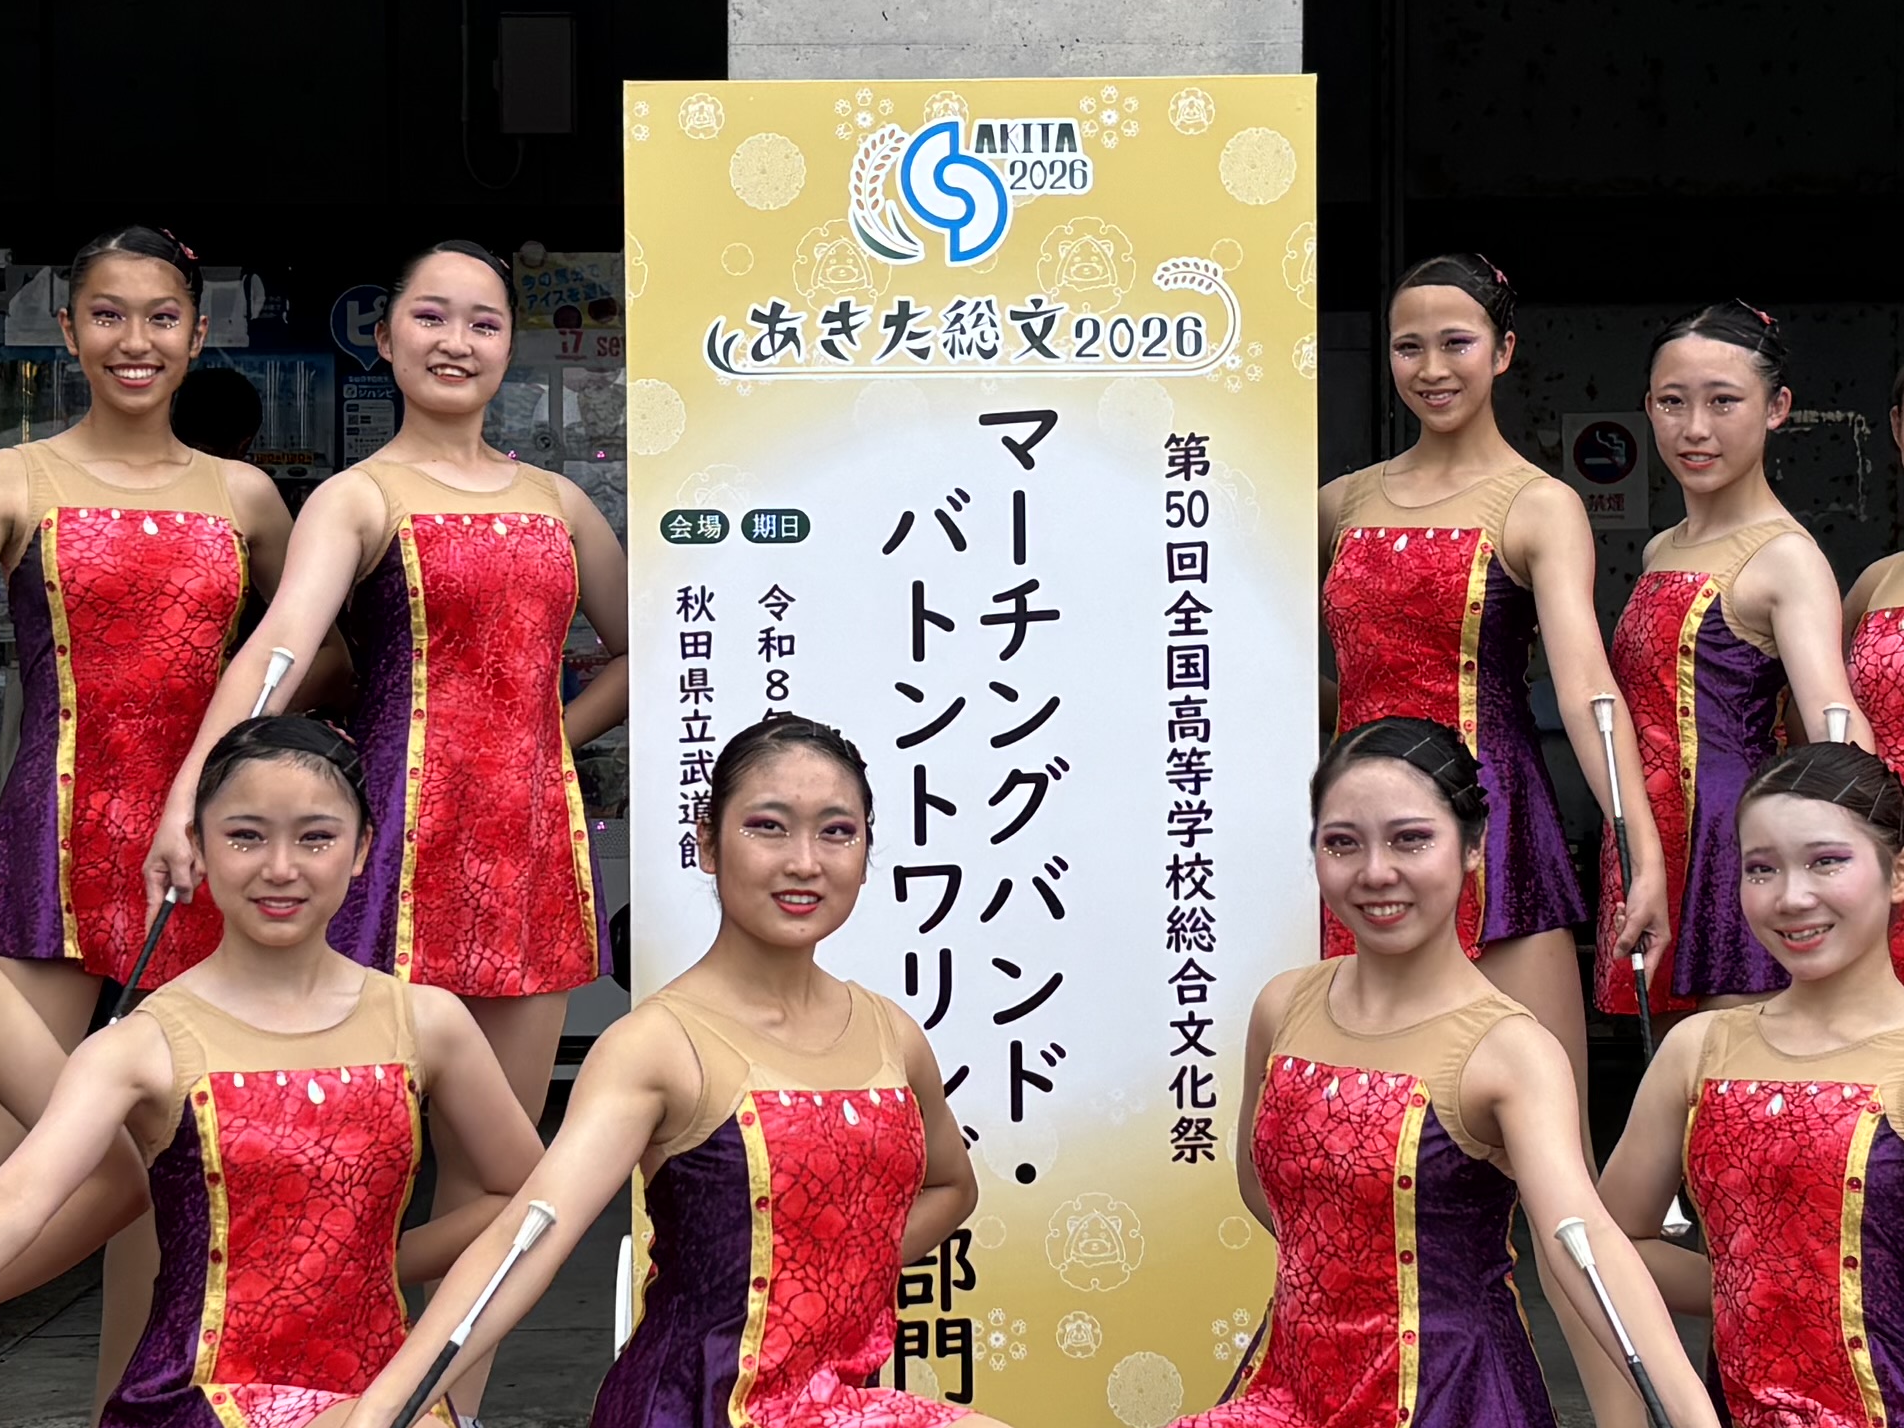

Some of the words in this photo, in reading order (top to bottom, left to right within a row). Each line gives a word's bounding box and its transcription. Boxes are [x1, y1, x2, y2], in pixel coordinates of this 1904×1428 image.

[974, 122, 1078, 154] AKITA
[1009, 159, 1088, 190] 2026
[749, 298, 1203, 362] あきた総文2026
[668, 516, 723, 541] 会場
[751, 514, 800, 539] 期日
[757, 583, 796, 721] 令和8
[1163, 432, 1218, 1164] 第50回全国高等学校総合文化祭
